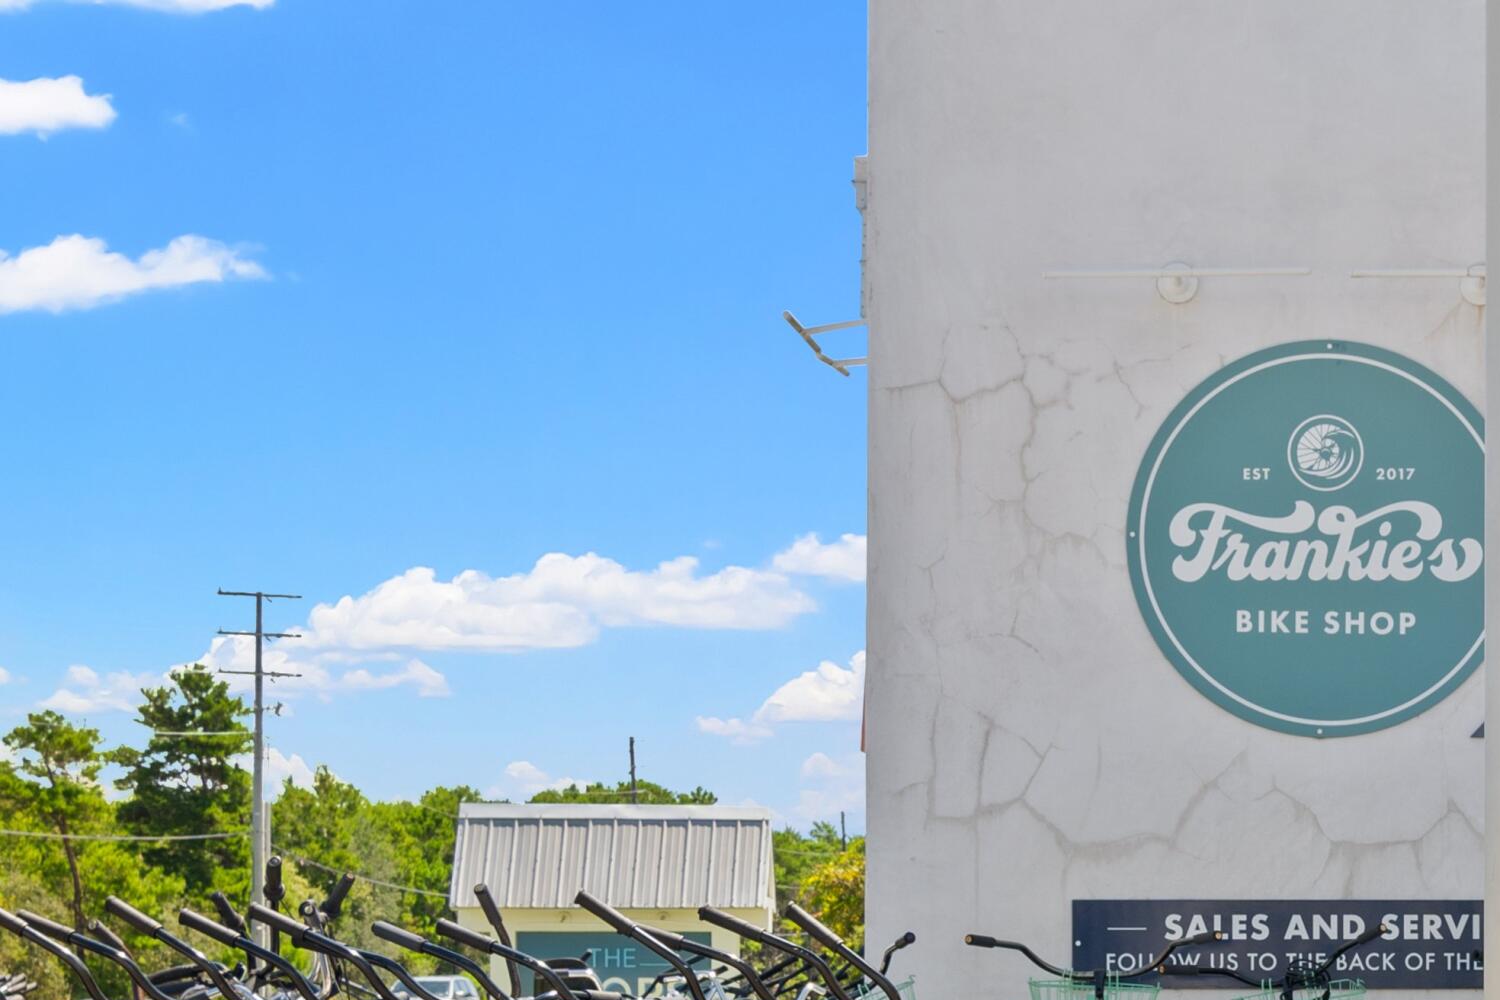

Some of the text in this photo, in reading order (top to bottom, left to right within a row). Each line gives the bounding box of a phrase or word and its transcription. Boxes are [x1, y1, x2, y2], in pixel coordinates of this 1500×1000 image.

[1242, 467, 1416, 481] EST 2017
[1235, 609, 1417, 636] BIKE SHOP
[1164, 913, 1481, 941] SALES AND SERVI
[590, 947, 637, 968] THE
[1209, 952, 1239, 972] US
[1246, 952, 1278, 972] TO
[1335, 952, 1396, 972] BACK
[1404, 952, 1436, 972] OF
